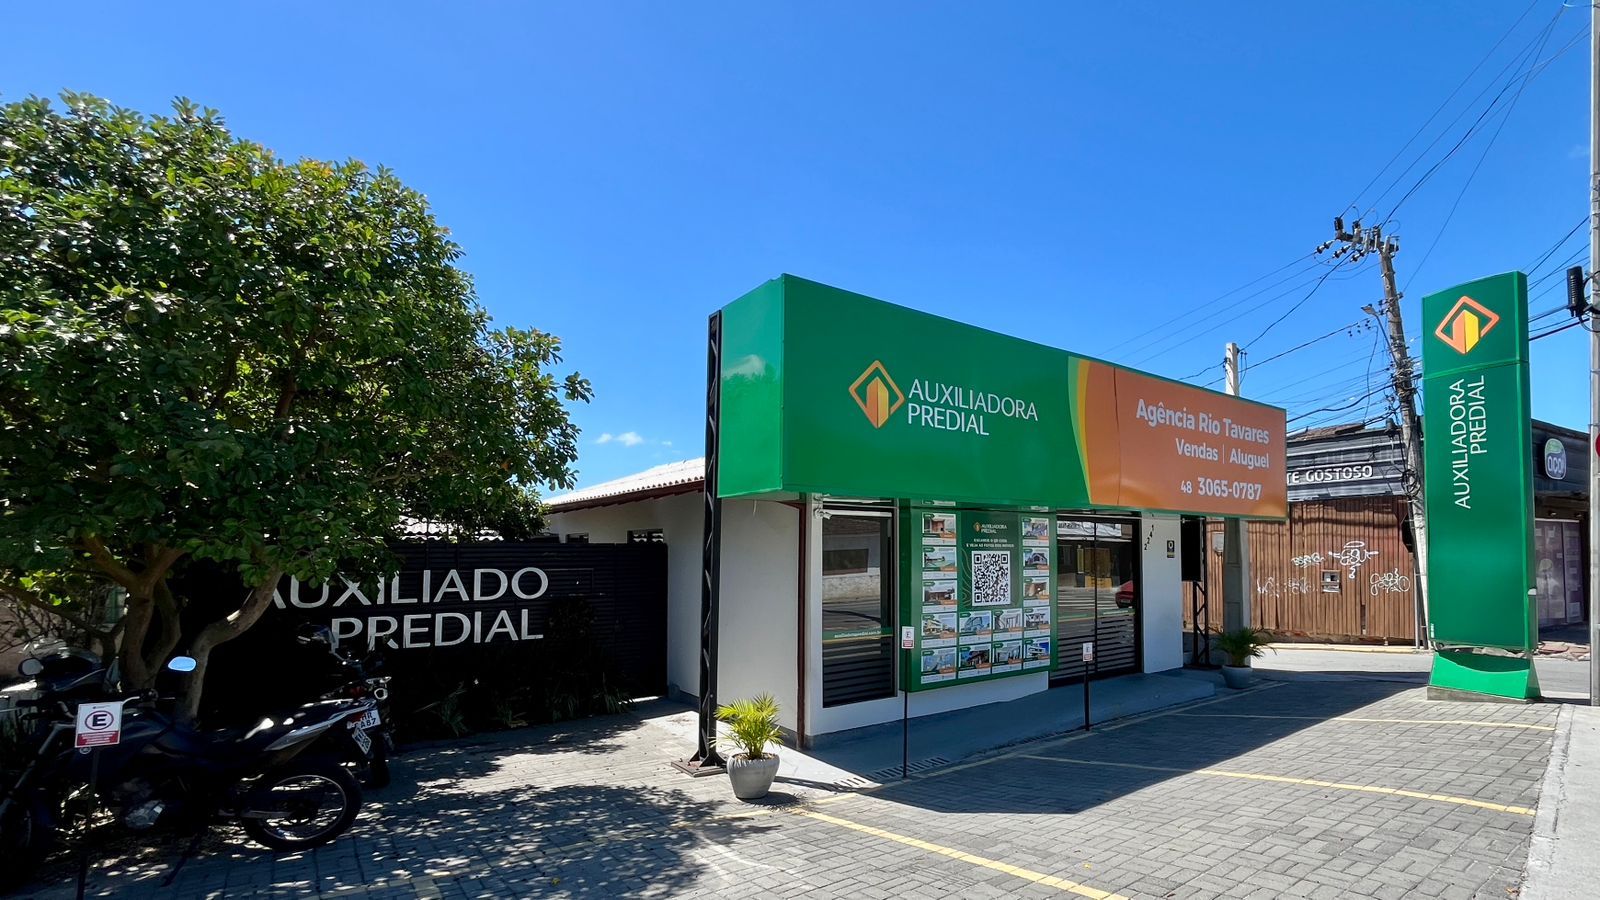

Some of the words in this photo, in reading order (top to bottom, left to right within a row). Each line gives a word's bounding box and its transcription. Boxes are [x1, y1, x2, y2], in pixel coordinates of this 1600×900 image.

[907, 378, 1039, 422] AUXILIADORA
[907, 402, 990, 436] PREDIAL
[1467, 374, 1488, 455] PREDIAL
[1136, 398, 1195, 427] Agência
[1198, 411, 1221, 435] Rio
[1223, 417, 1270, 445] Tavares
[1175, 437, 1219, 462] Vendas
[1229, 447, 1270, 469] Aluguel
[1449, 378, 1471, 509] AUXILIADORA
[1180, 479, 1193, 495] 48
[1197, 476, 1262, 501] 3065-0787
[1305, 464, 1374, 483] GOSTOSO
[331, 608, 545, 650] PREDIAL
[92, 714, 107, 727] E
